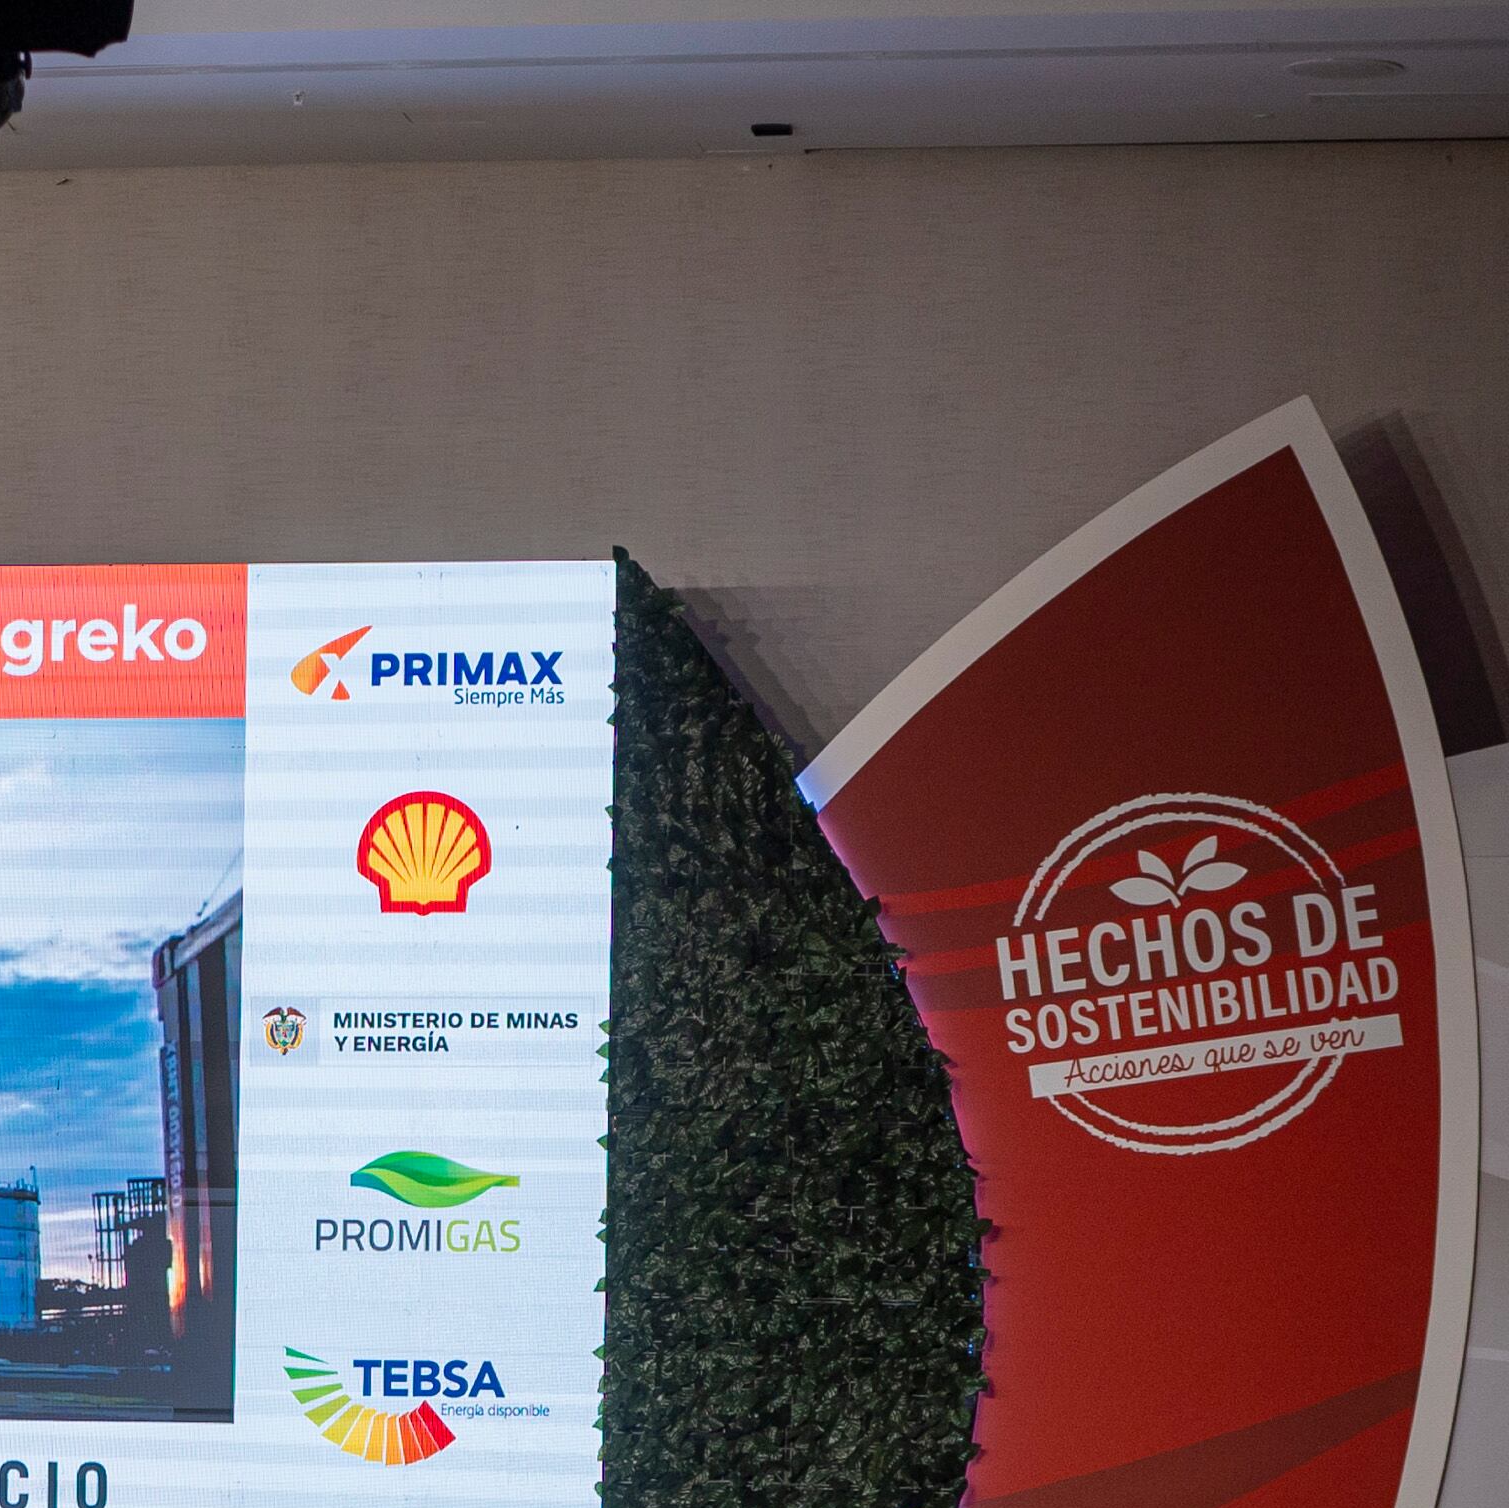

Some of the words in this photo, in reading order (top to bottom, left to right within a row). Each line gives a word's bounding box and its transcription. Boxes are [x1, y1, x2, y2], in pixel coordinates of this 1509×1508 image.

[371, 651, 565, 687] PRIMAX
[453, 687, 525, 708] Siempre
[530, 686, 566, 706] Más
[996, 901, 1273, 1001] HECHOS
[1292, 884, 1383, 959] DE
[333, 1011, 464, 1029] MINISTERIO
[470, 1012, 500, 1029] DE
[506, 1012, 579, 1030] MINAS
[1006, 957, 1399, 1055] SOSTENIBILIDAD
[334, 1035, 350, 1052] Y
[353, 1030, 449, 1053] ENERGÍA
[1062, 1056, 1195, 1089] Acciones
[1204, 1046, 1257, 1073] que
[1263, 1035, 1301, 1060] se
[1310, 1027, 1365, 1053] ven
[315, 1219, 521, 1253] PROMIGAS
[353, 1359, 506, 1399] TEBSA
[441, 1404, 484, 1420] Energía
[487, 1403, 550, 1419] disponible
